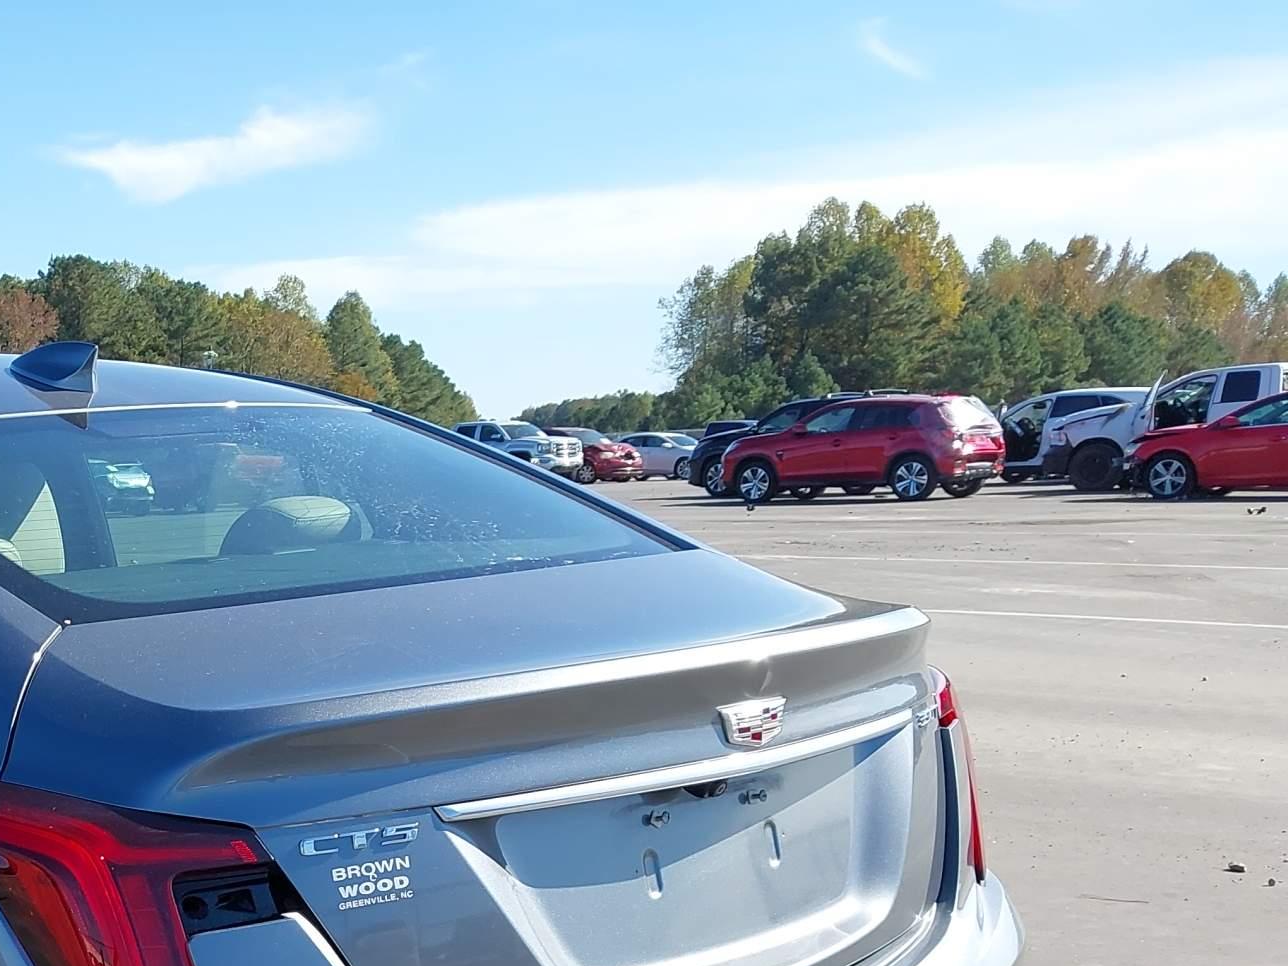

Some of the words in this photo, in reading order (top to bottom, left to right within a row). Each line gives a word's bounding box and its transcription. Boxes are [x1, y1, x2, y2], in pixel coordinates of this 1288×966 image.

[331, 856, 411, 881] BROWN
[338, 876, 410, 898] WOOD
[338, 893, 399, 910] GREENVILLE,
[400, 890, 414, 899] NC
